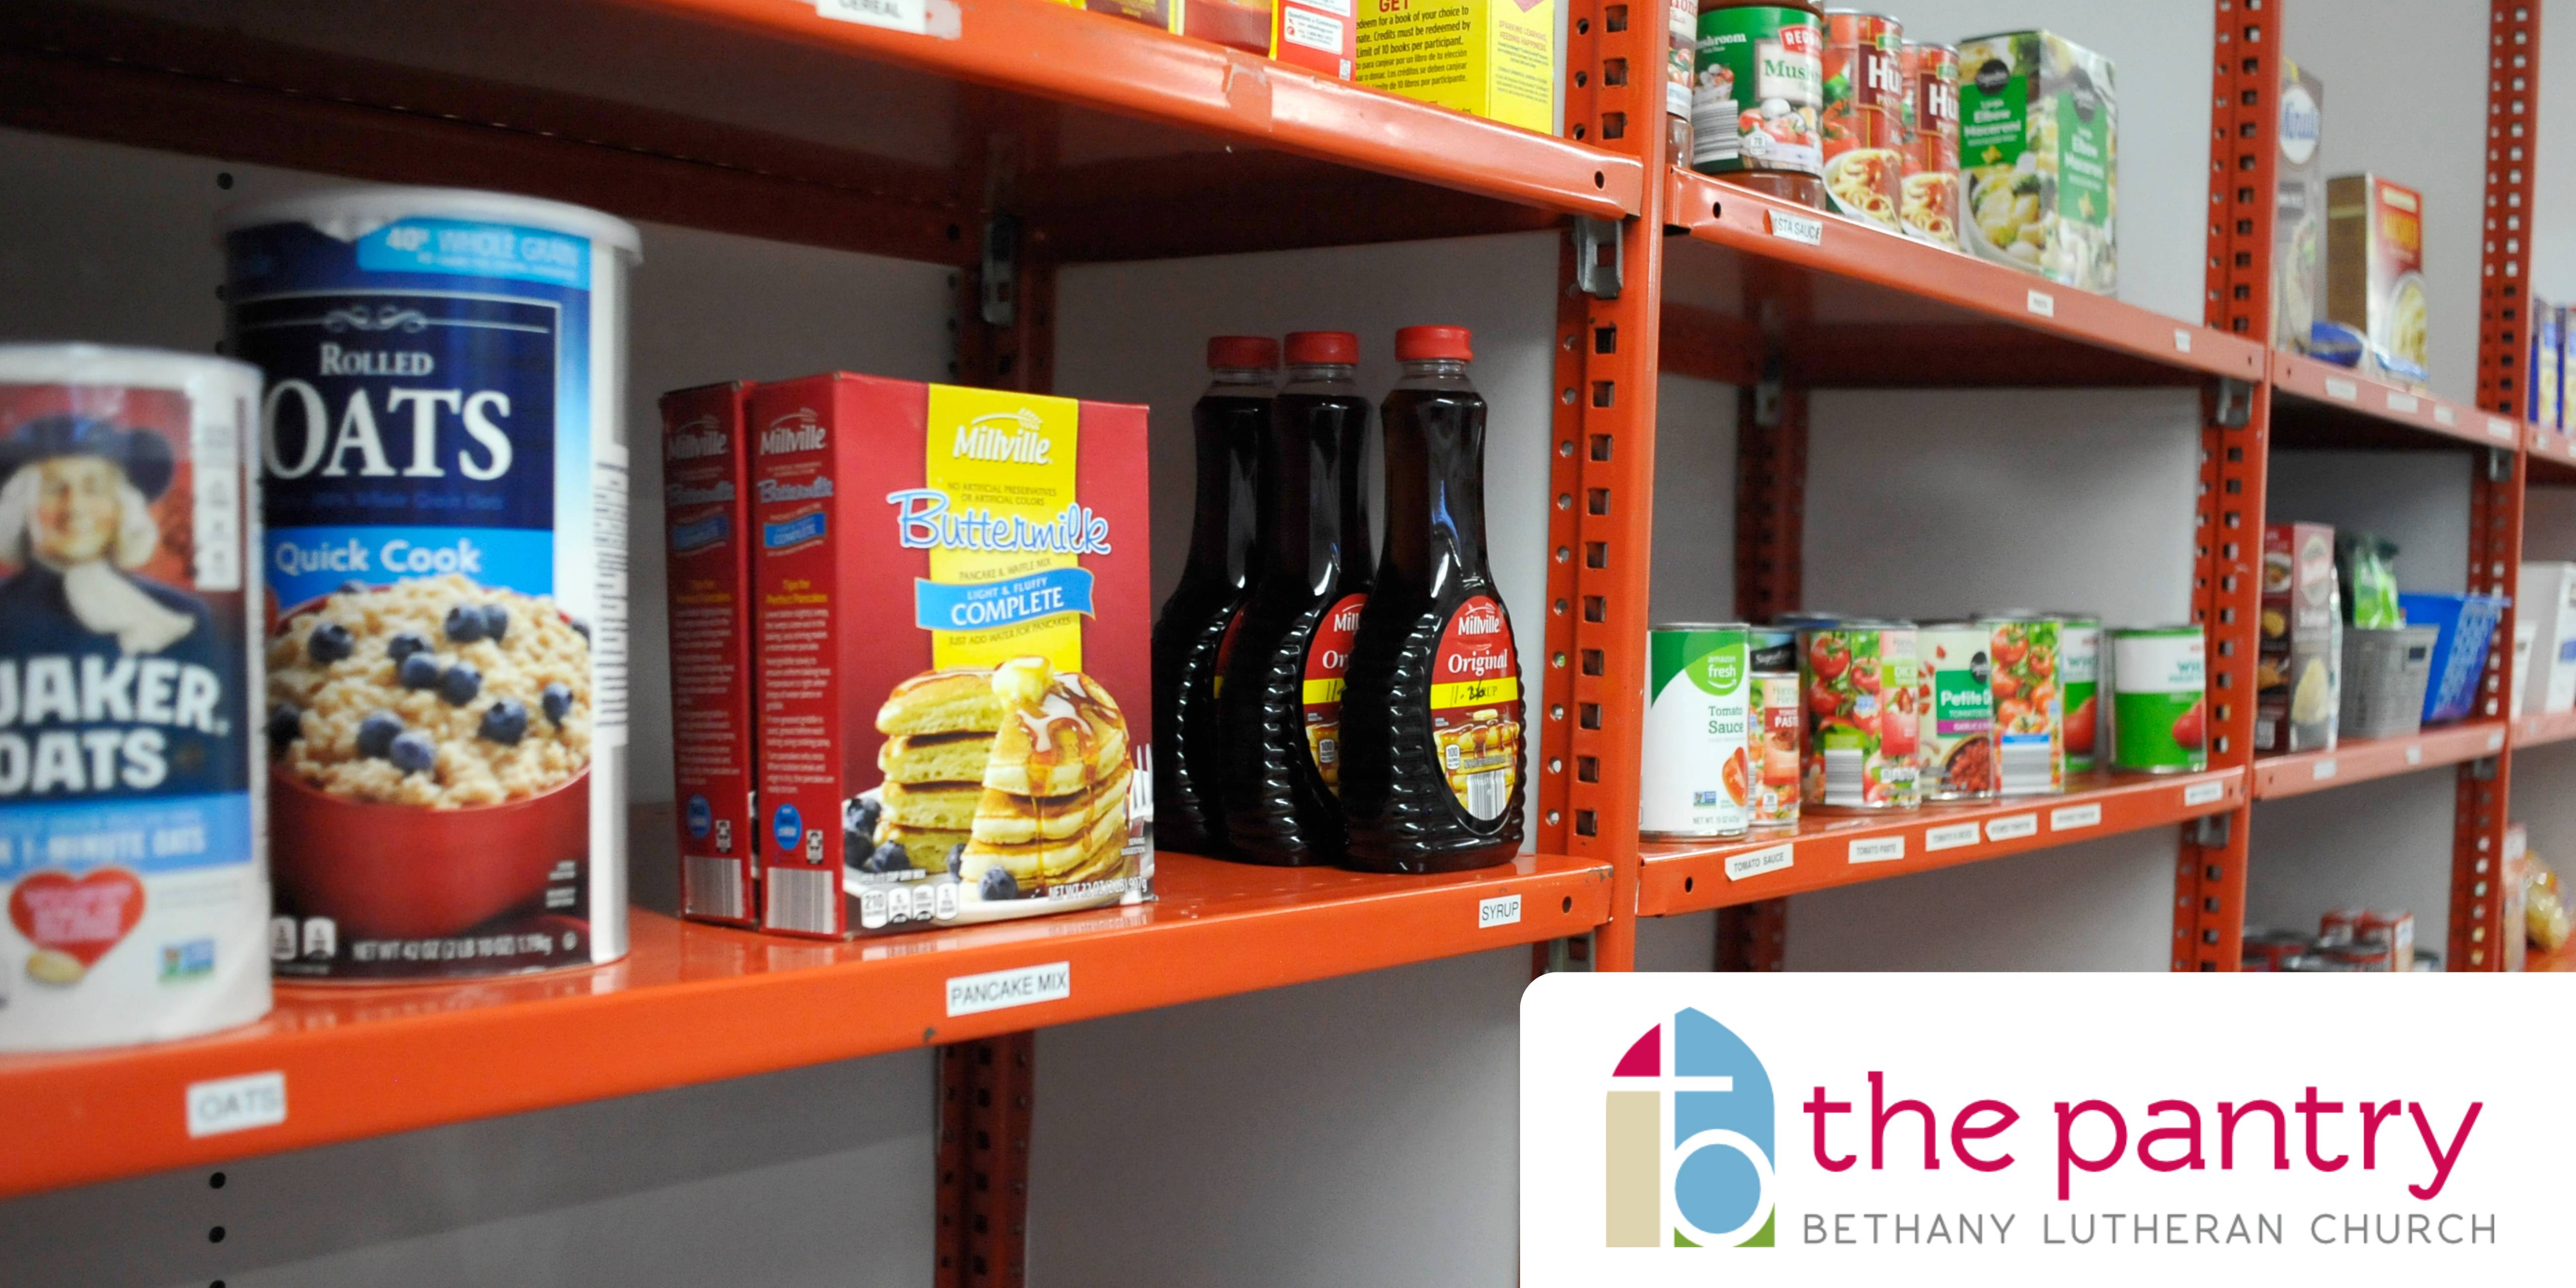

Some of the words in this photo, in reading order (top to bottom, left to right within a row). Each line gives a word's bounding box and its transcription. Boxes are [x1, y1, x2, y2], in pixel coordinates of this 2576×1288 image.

[1357, 19, 1377, 29] edeem
[1378, 16, 1388, 26] for
[1395, 13, 1411, 23] book
[1413, 10, 1420, 21] of
[1422, 10, 1437, 22] your
[1439, 6, 1460, 18] choice
[1461, 6, 1469, 15] to
[1373, 30, 1396, 41] Credits
[1397, 27, 1413, 37] must
[1416, 25, 1424, 35] be
[1425, 21, 1460, 34] redeemed
[1462, 20, 1471, 32] by
[1357, 46, 1372, 58] Limit
[1373, 45, 1381, 55] of
[1382, 44, 1389, 54] 10
[1390, 42, 1410, 54] books
[1412, 41, 1423, 53] per
[1425, 36, 1463, 50] participant.
[1362, 61, 1374, 70] para
[1396, 57, 1405, 66] por
[1415, 54, 1427, 62] libro
[1427, 64, 1445, 73] deben
[1397, 80, 1404, 88] 10
[1973, 109, 2012, 124] Elbow
[1963, 119, 2021, 137] Macaroni
[1774, 217, 1793, 232] STA
[1794, 223, 1821, 240] SAUCE
[438, 230, 517, 259] WHOLE
[320, 342, 434, 377] ROLLED
[263, 379, 513, 481] OATS
[760, 425, 827, 455] Millville
[952, 425, 1053, 465] Millville
[962, 493, 972, 502] OR
[975, 494, 1013, 504] ARTIFICIAL
[1015, 497, 1045, 506] COLORS
[963, 483, 1002, 493] ARTIFICIAL
[1004, 484, 1057, 497] PRESERVATIVES
[887, 488, 1112, 555] Buttermilk
[276, 537, 369, 576] Quick
[380, 537, 482, 573] Cook
[959, 569, 995, 581] PANCAKE
[997, 568, 1004, 576] &
[1007, 561, 1034, 574] WAFFLE
[1037, 558, 1051, 567] MIX
[967, 587, 999, 601] LIGHT
[1001, 585, 1010, 596] &
[1014, 576, 1048, 593] FLUFFY
[951, 586, 1064, 626] COMPLETE
[950, 636, 966, 646] JUST
[969, 635, 987, 644] ADD
[990, 630, 1015, 642] WATER
[1016, 625, 1031, 637] FOR
[1032, 617, 1071, 631] PANCAKES
[1334, 612, 1360, 632] Mill
[1458, 615, 1501, 636] Millville
[1322, 650, 1349, 669] Or
[1448, 648, 1508, 676] Original
[1708, 664, 1736, 678] fresh
[0, 654, 220, 734] UAKER
[1940, 690, 1982, 707] Petite
[1708, 706, 1743, 717] Tomato
[1708, 720, 1744, 734] Sauce
[0, 727, 167, 794] OATS
[1448, 747, 1458, 757] 100
[1856, 845, 1879, 856] TOMATO
[1880, 844, 1896, 854] PASTE
[1734, 858, 1761, 873] TOMATO
[1763, 852, 1784, 866] SAUCE
[1481, 901, 1519, 921] SYRUP
[352, 941, 376, 961] NET
[951, 975, 1033, 1007] PANCAKE
[1037, 970, 1067, 992] MIX
[199, 1088, 278, 1123] OATS
